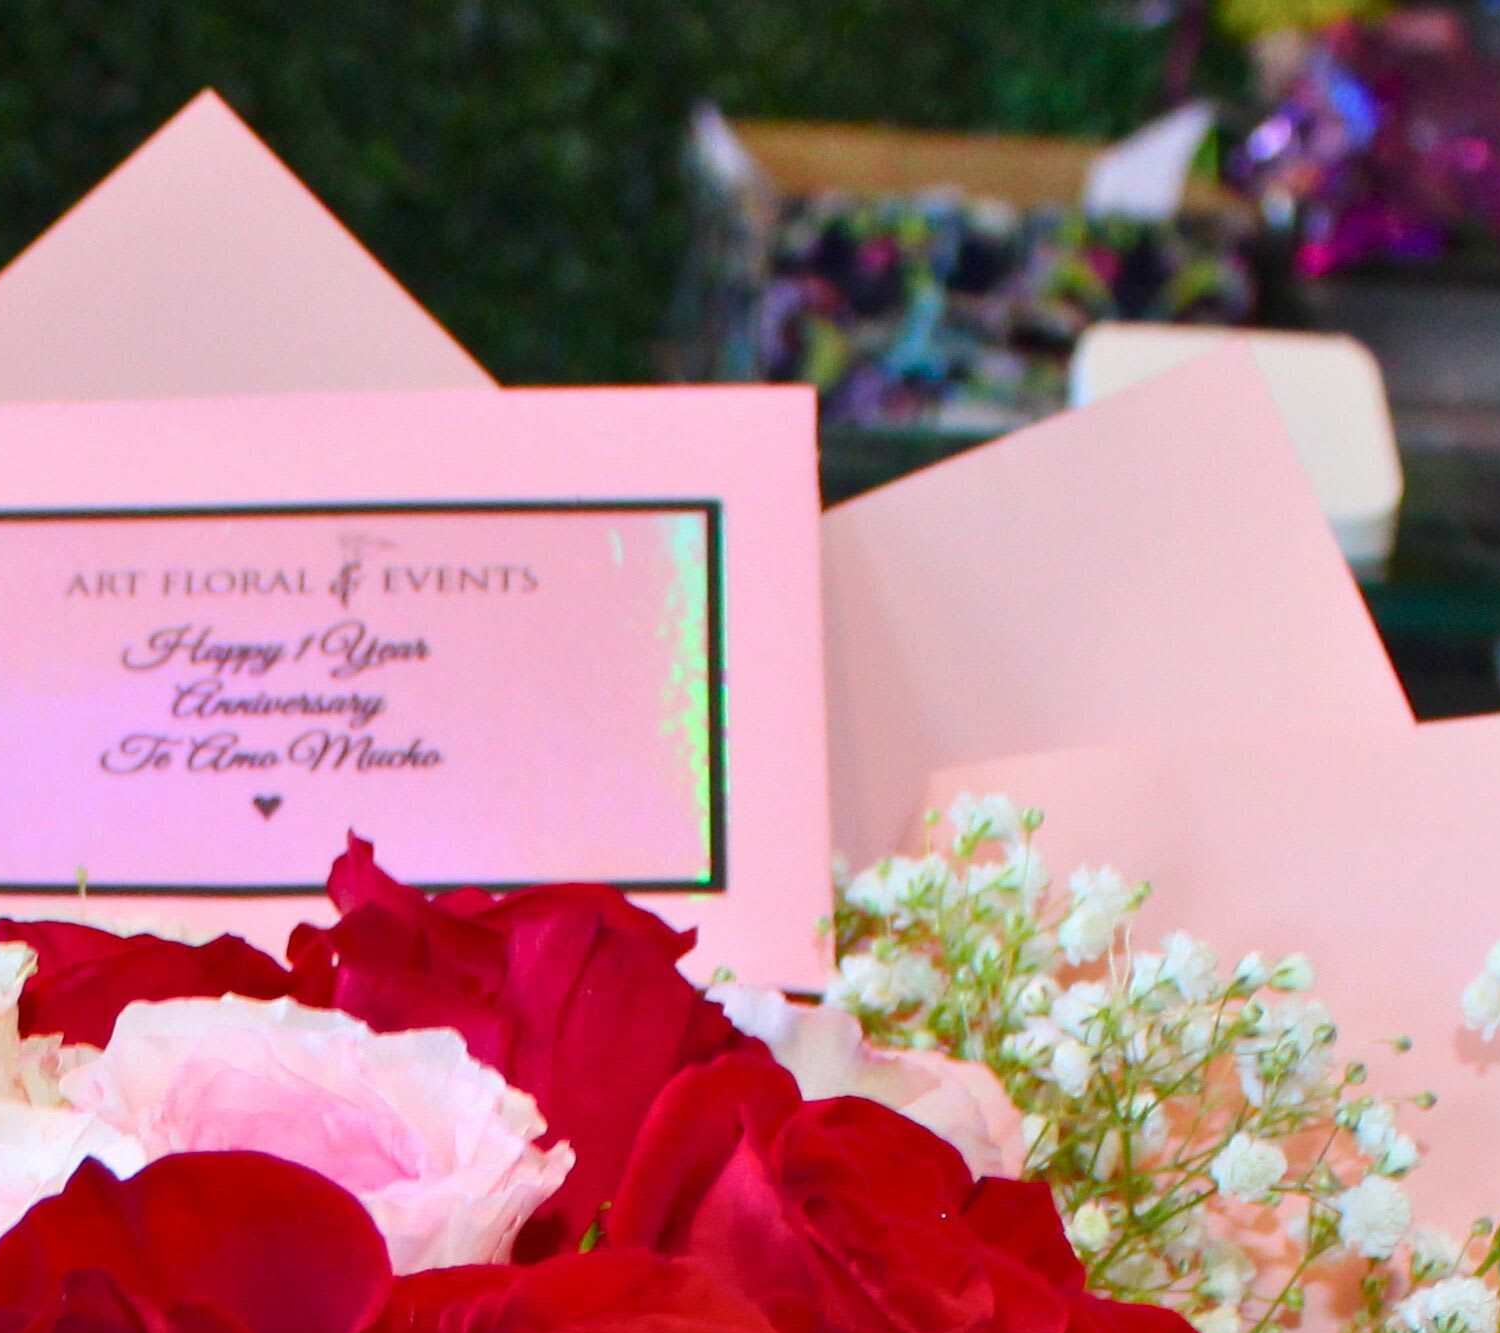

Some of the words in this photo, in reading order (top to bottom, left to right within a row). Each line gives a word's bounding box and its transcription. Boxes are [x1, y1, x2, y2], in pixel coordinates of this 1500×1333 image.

[65, 571, 146, 598] ART
[162, 568, 318, 597] FLORAL
[382, 564, 540, 595] EVENTS
[121, 622, 288, 676] Happy
[294, 631, 320, 660] 1
[320, 618, 432, 679] Year
[171, 679, 387, 729] Anniversary
[101, 732, 182, 775] Te
[187, 731, 280, 771] Amo
[287, 730, 444, 774] Mucho
